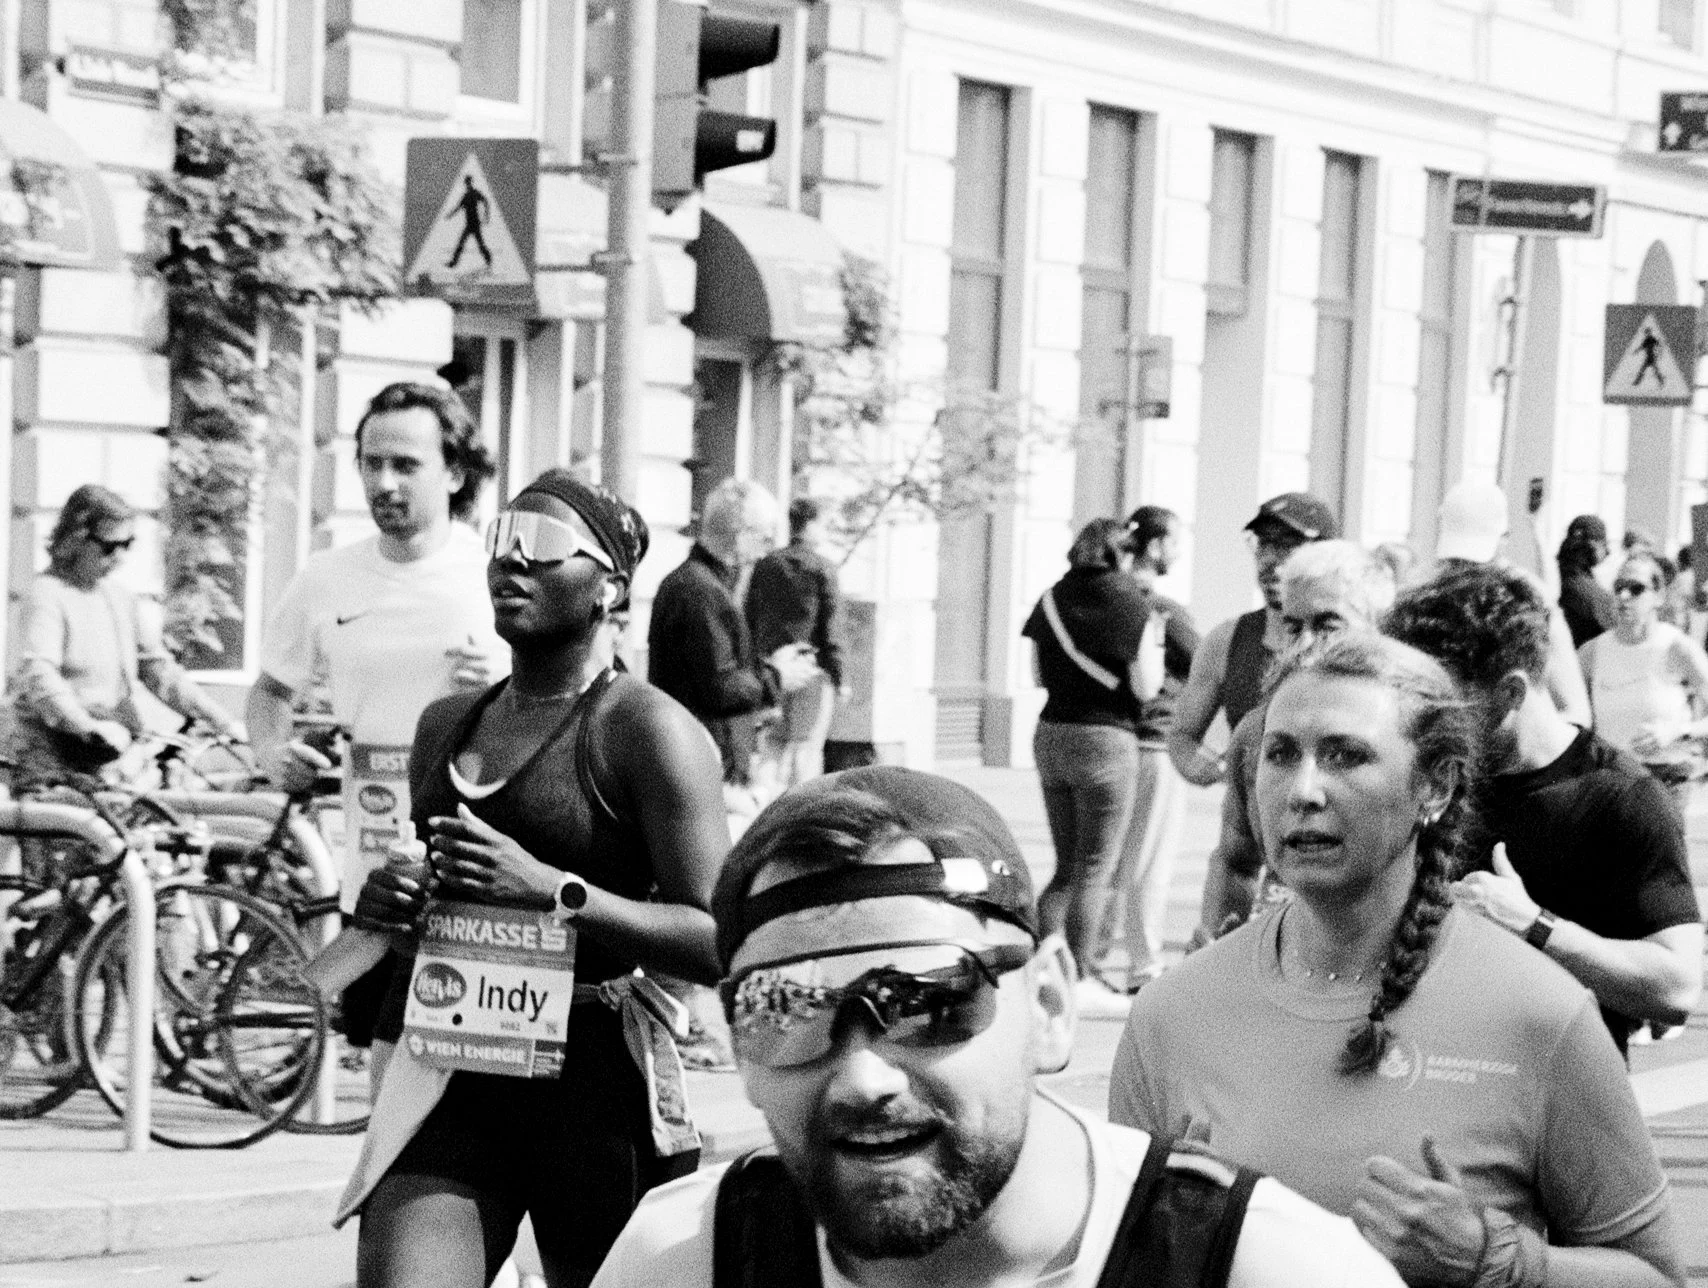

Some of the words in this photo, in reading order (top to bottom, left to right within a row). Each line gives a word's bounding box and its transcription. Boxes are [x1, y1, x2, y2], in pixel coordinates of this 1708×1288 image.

[426, 914, 537, 950] SPARKASSE
[478, 976, 549, 1022] Indy
[425, 1039, 461, 1058] WIEN
[463, 1044, 526, 1064] ENERGIE
